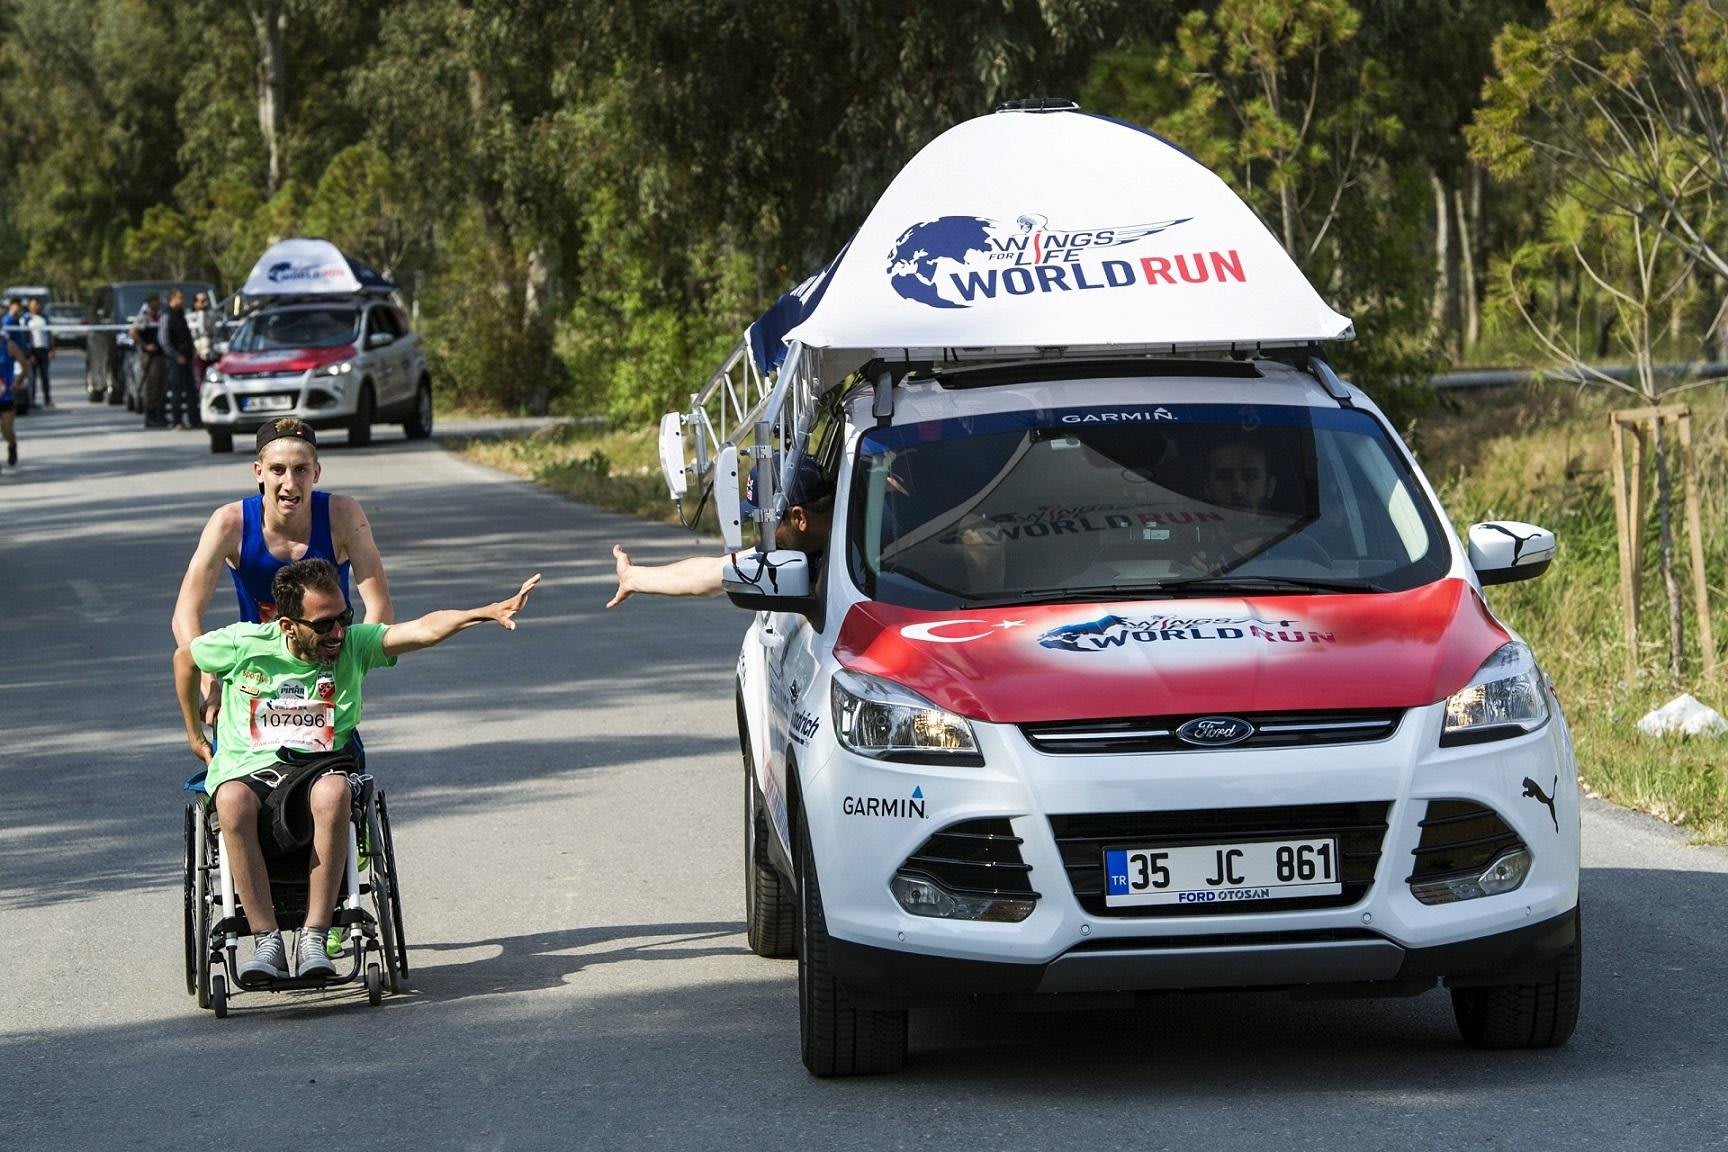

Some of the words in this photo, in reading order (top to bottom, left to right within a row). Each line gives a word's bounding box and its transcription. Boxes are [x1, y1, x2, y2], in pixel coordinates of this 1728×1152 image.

[991, 230, 1115, 252] WINGS
[989, 252, 1014, 261] FOR
[1014, 248, 1084, 266] LIFE
[949, 260, 1137, 301] WORLD
[1139, 249, 1247, 286] RUN
[1061, 411, 1173, 424] GARMIN
[985, 513, 1134, 541] WORLD
[1136, 510, 1226, 526] RUN
[1090, 627, 1244, 649] WORLD
[1250, 624, 1337, 644] RUN
[260, 713, 325, 728] 107096
[1194, 720, 1236, 739] Ford
[843, 796, 925, 819] GARMIN
[1111, 875, 1127, 886] TR
[1130, 852, 1170, 891] 35
[1206, 849, 1245, 886] JC
[1276, 843, 1332, 882] 861
[1178, 891, 1215, 903] FORD
[1218, 888, 1270, 901] OTOSAN
